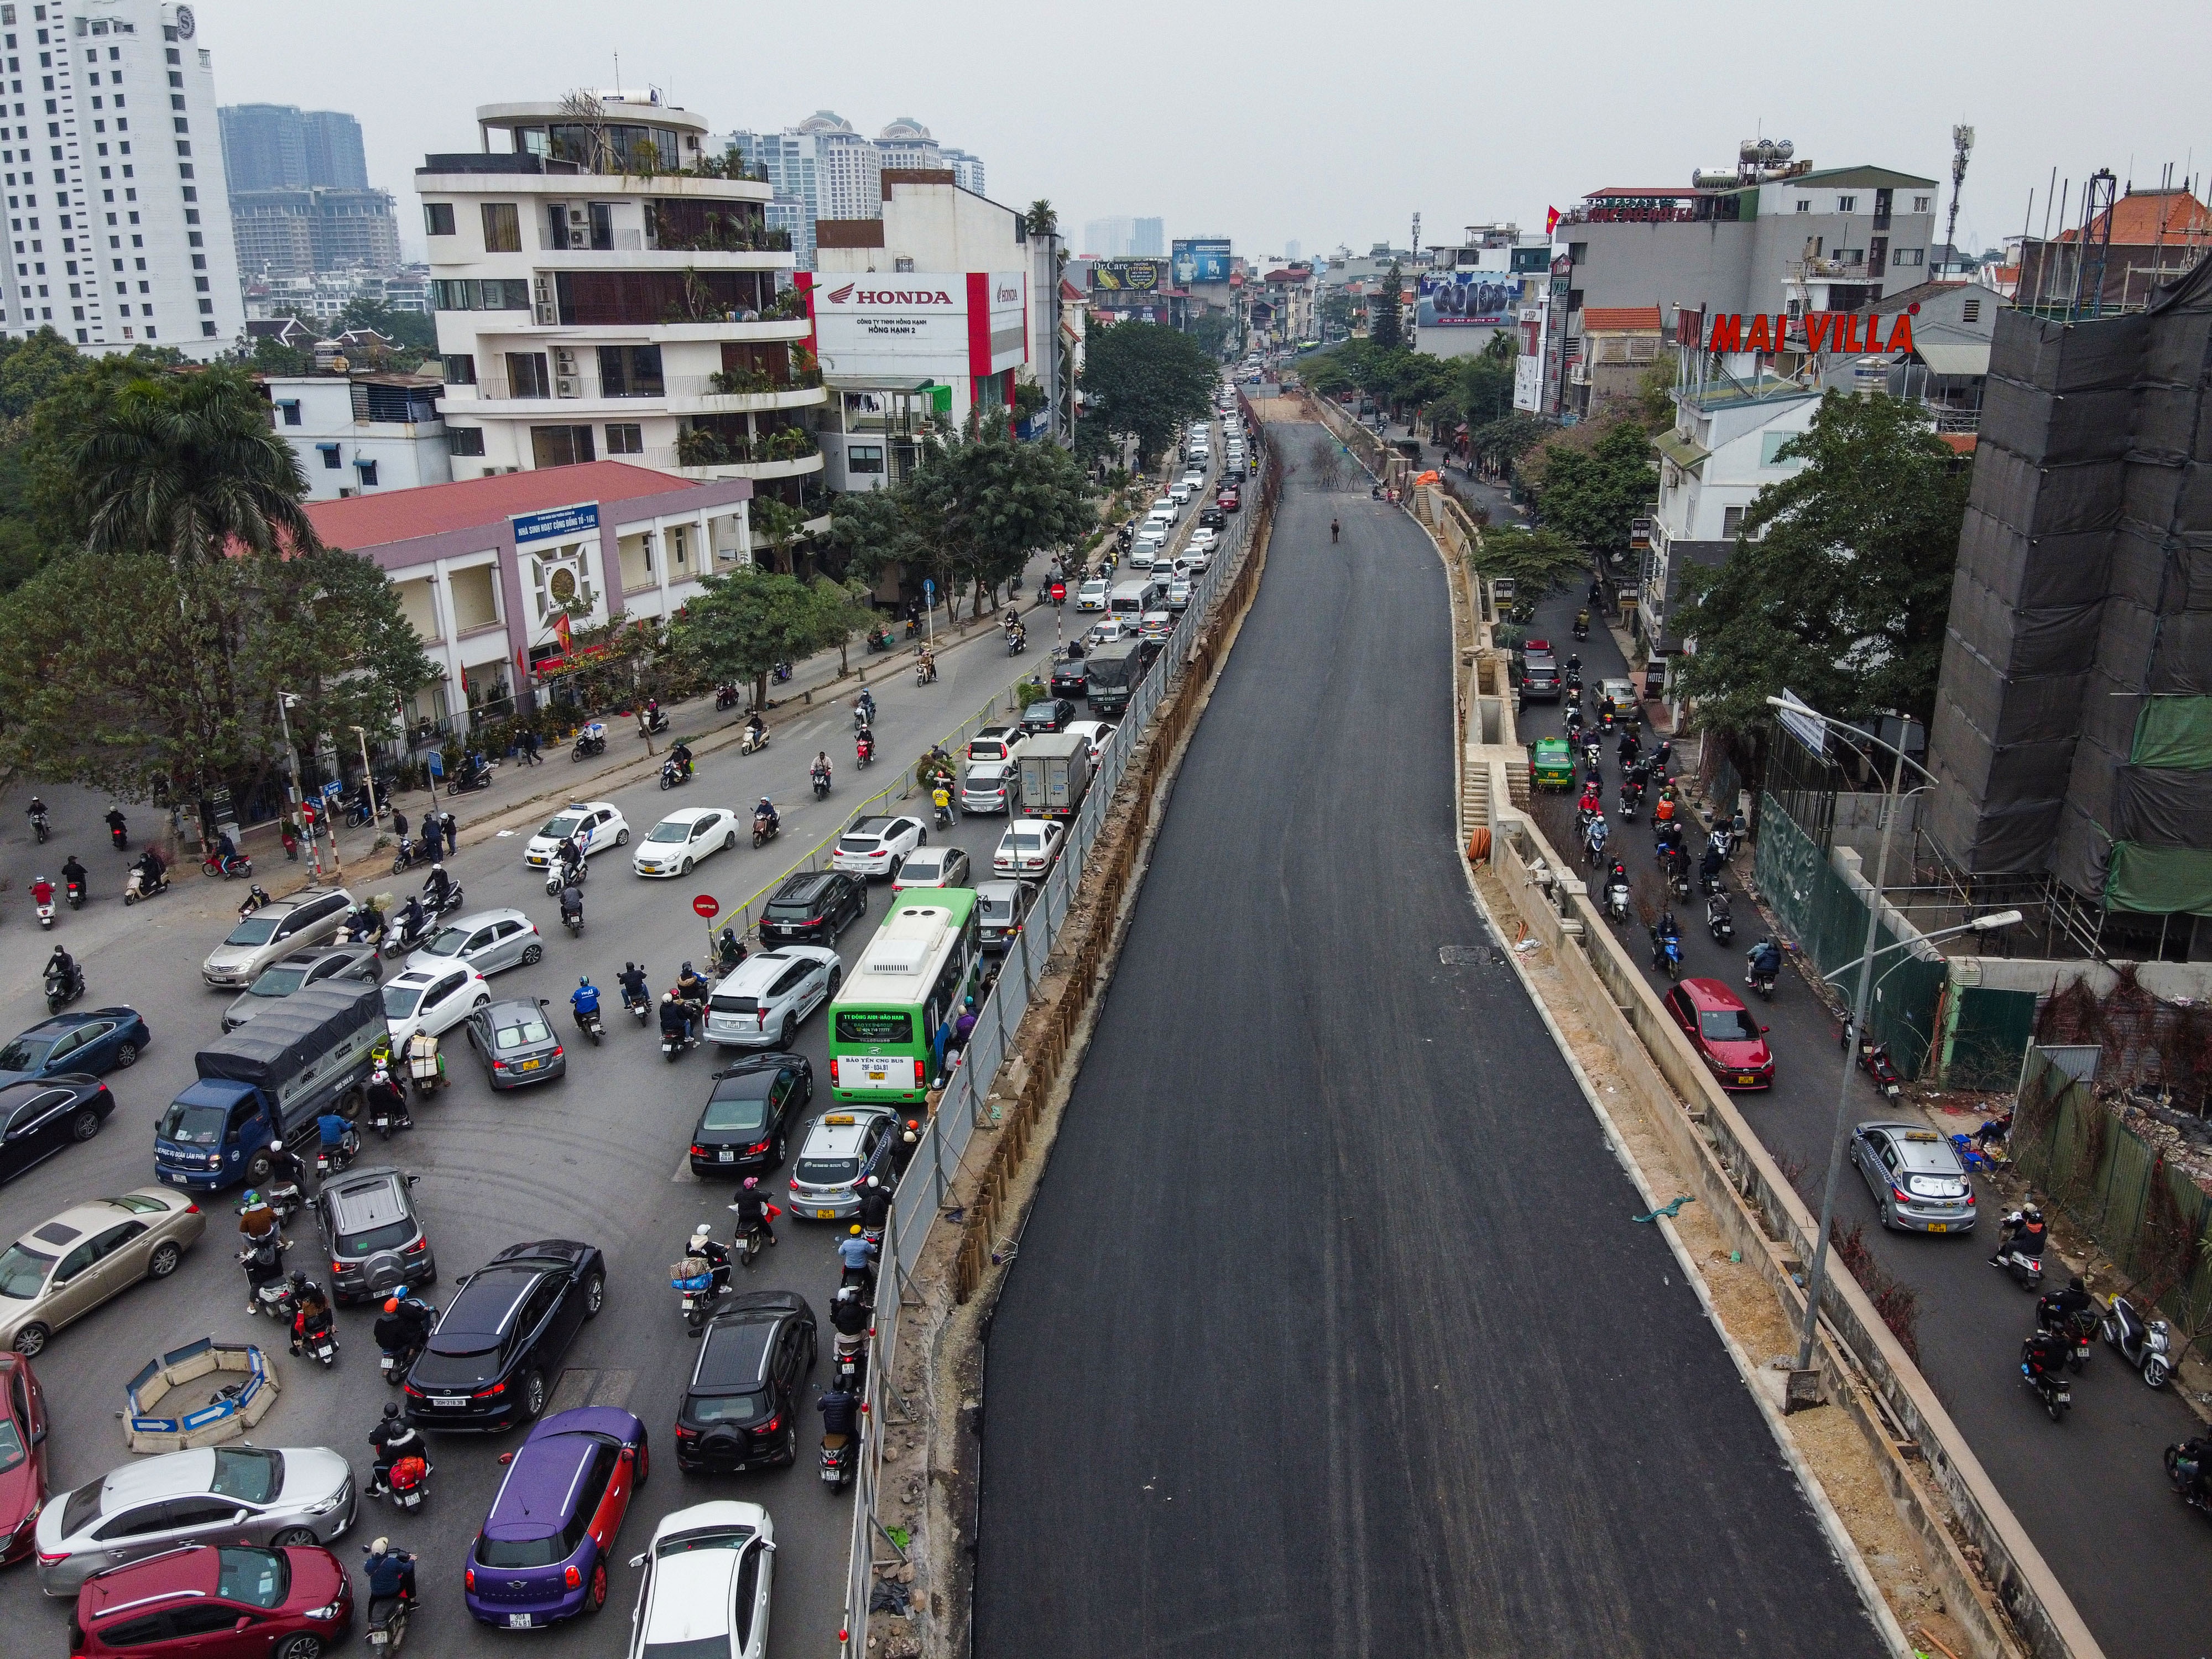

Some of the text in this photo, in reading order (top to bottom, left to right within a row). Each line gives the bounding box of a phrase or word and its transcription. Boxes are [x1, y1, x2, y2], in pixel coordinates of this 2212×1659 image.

[180, 15, 190, 29] S
[1552, 281, 1567, 295] VIP
[857, 291, 953, 304] HONDA
[1001, 289, 1018, 302] HONDA
[868, 325, 889, 333] HỒNG
[1708, 314, 1788, 352] MAI
[1804, 314, 1914, 353] VILLA
[518, 527, 529, 536] NHÀ
[529, 525, 541, 534] SINH
[541, 523, 552, 533] HOẠT
[553, 520, 565, 531] CỘNG
[566, 516, 578, 527] ĐỒNG
[578, 514, 584, 524] TỔ
[1648, 672, 1664, 683] HOTEL
